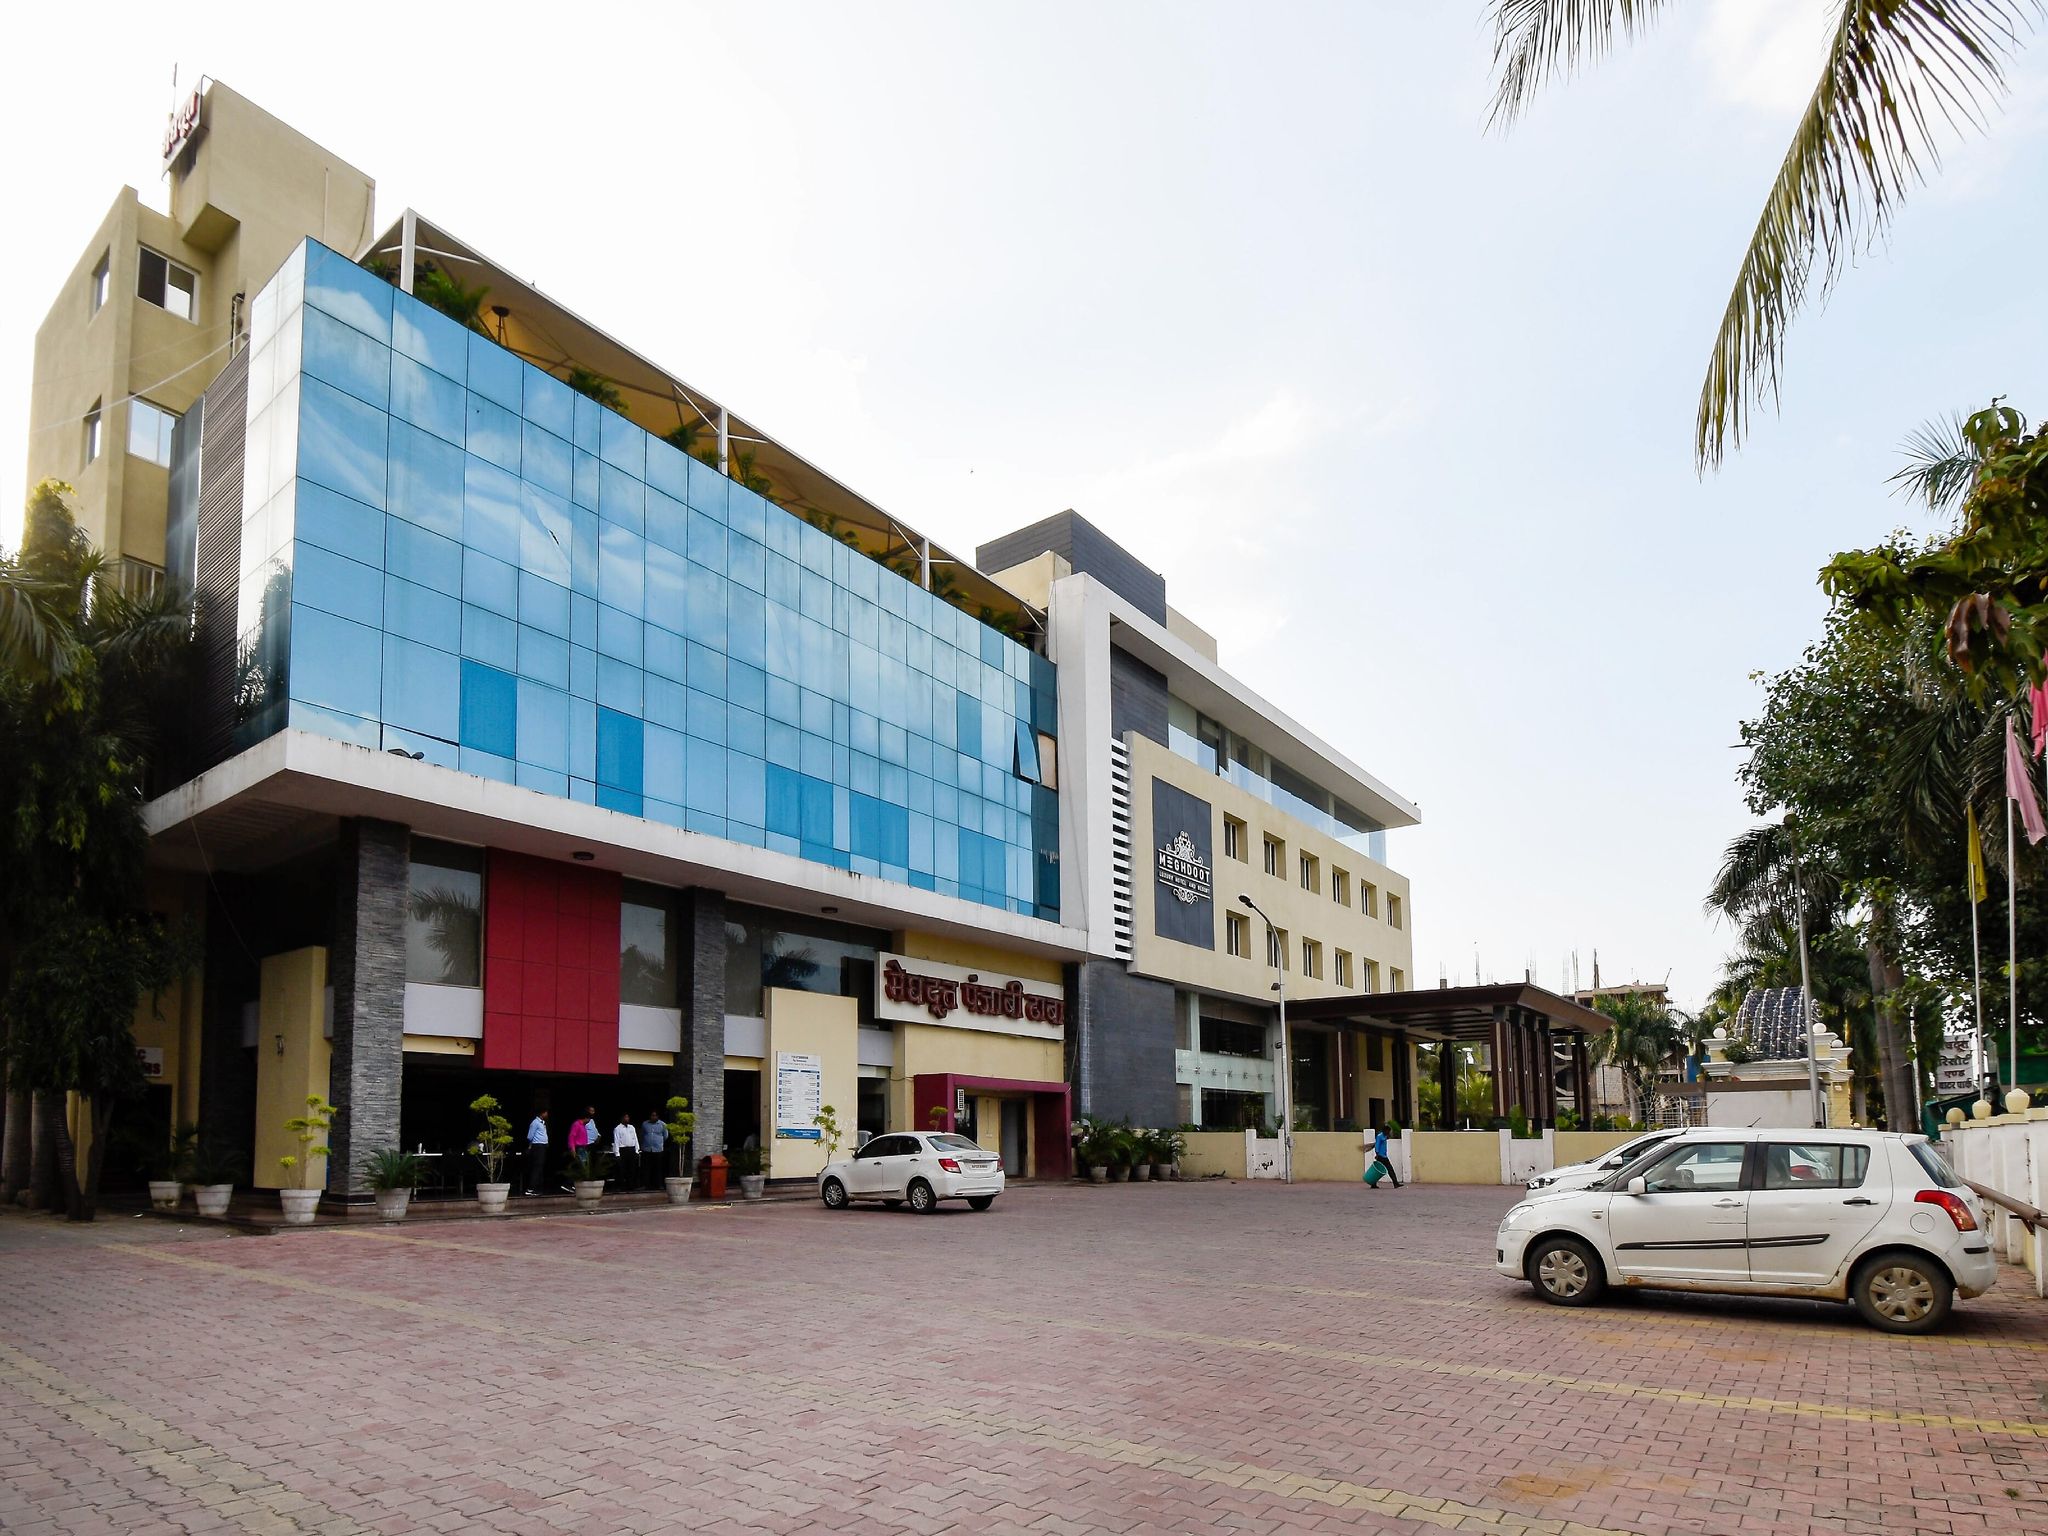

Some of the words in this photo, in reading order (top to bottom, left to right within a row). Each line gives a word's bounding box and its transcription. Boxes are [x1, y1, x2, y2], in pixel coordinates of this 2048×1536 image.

[1160, 853, 1209, 882] MEGHDOOT
[884, 959, 959, 1019] मेघदूत
[960, 974, 1023, 1019] पंजाबी
